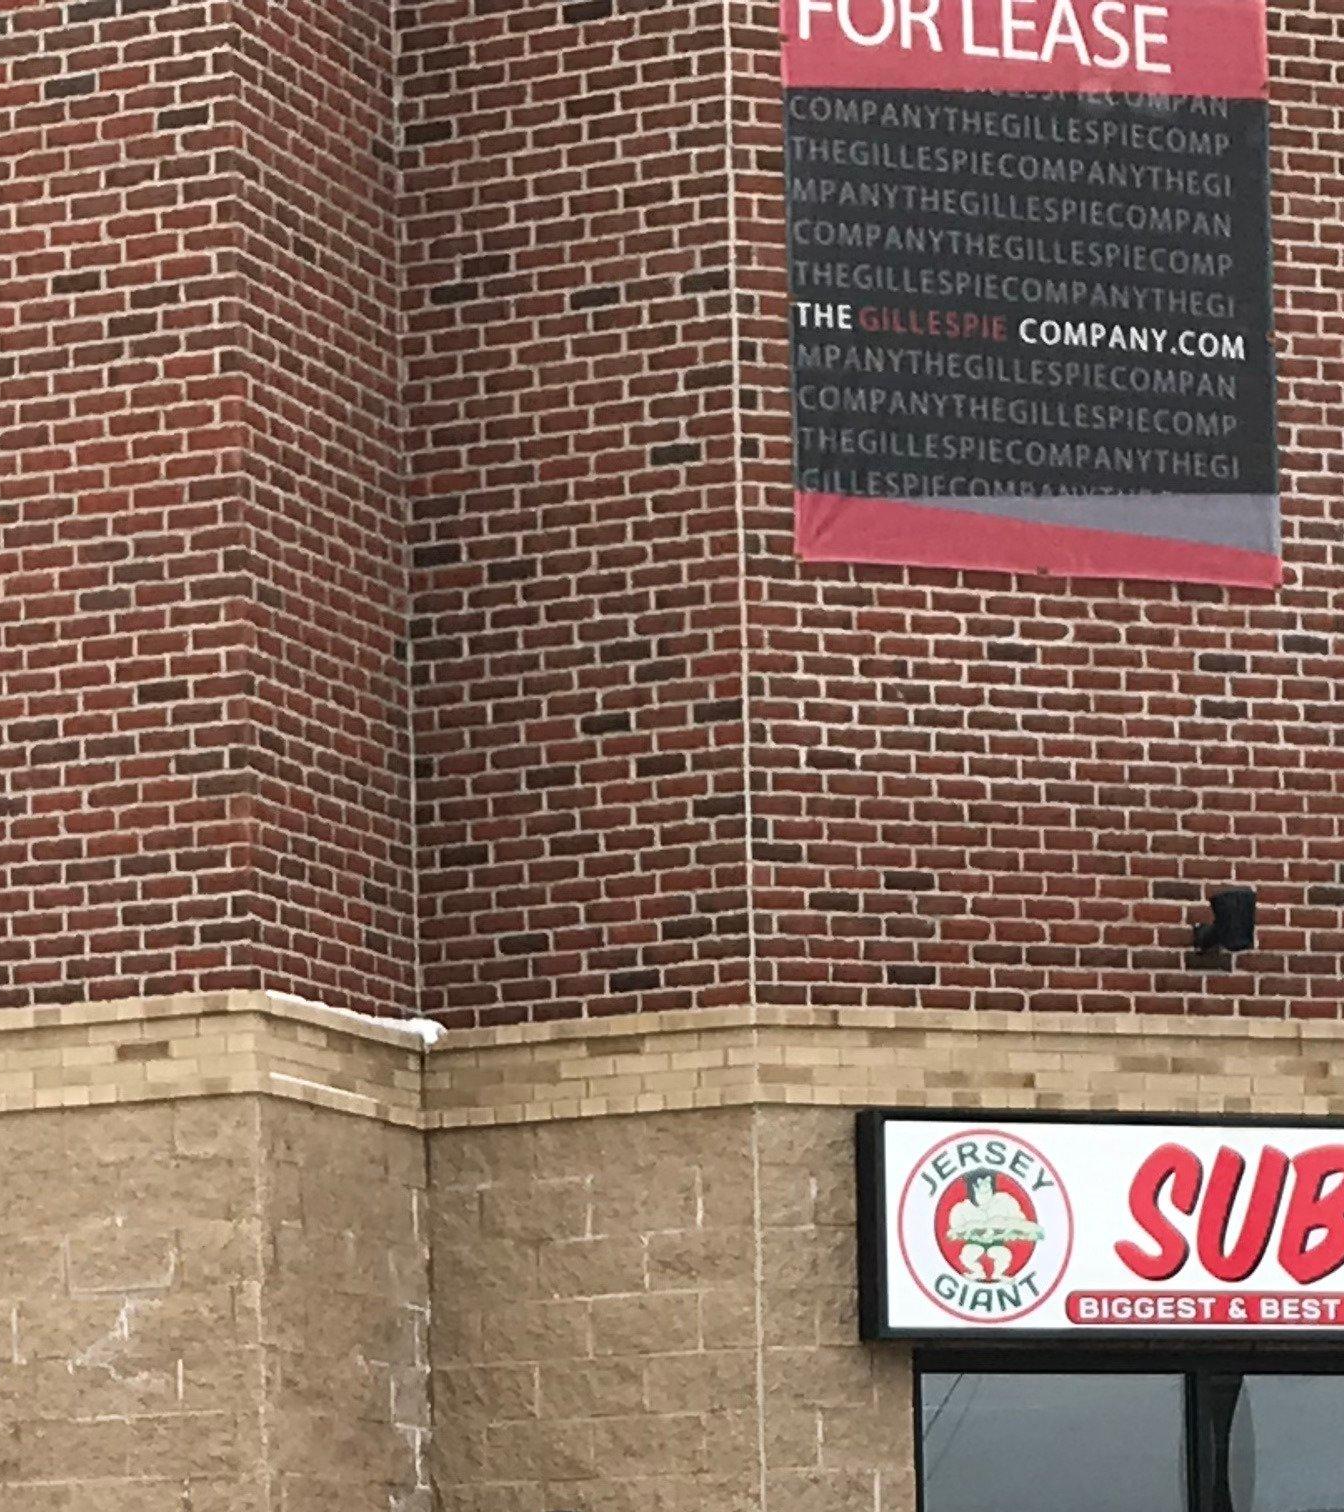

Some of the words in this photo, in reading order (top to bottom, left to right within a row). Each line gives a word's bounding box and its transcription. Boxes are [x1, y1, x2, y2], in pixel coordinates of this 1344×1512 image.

[798, 0, 943, 52] FOR
[962, 0, 1172, 73] LEASE
[789, 96, 1231, 155] COMPANYTHEGILLESPIECOMP
[791, 136, 1232, 197] THEGILLESPIECOMPANYTHEGI
[793, 219, 1233, 276] COMPANYTHEGILLESPIECOMP
[794, 260, 1235, 318] THEGILLESPIECOMPANYTHEGI
[795, 302, 853, 330] THE
[858, 305, 1007, 341] GILLESPIE
[1018, 317, 1246, 361] COMPANY.COM
[798, 385, 1237, 436] COMPANYTHEGILLESPIECOMP
[800, 427, 1239, 480] THEGILLESPIECOMPANYTHEGI
[921, 1141, 1054, 1197] JERSEY
[934, 1271, 1040, 1313] GIANT
[1079, 1297, 1216, 1320] BIGGEST
[1228, 1299, 1249, 1320] &
[1260, 1298, 1341, 1321] BEST
